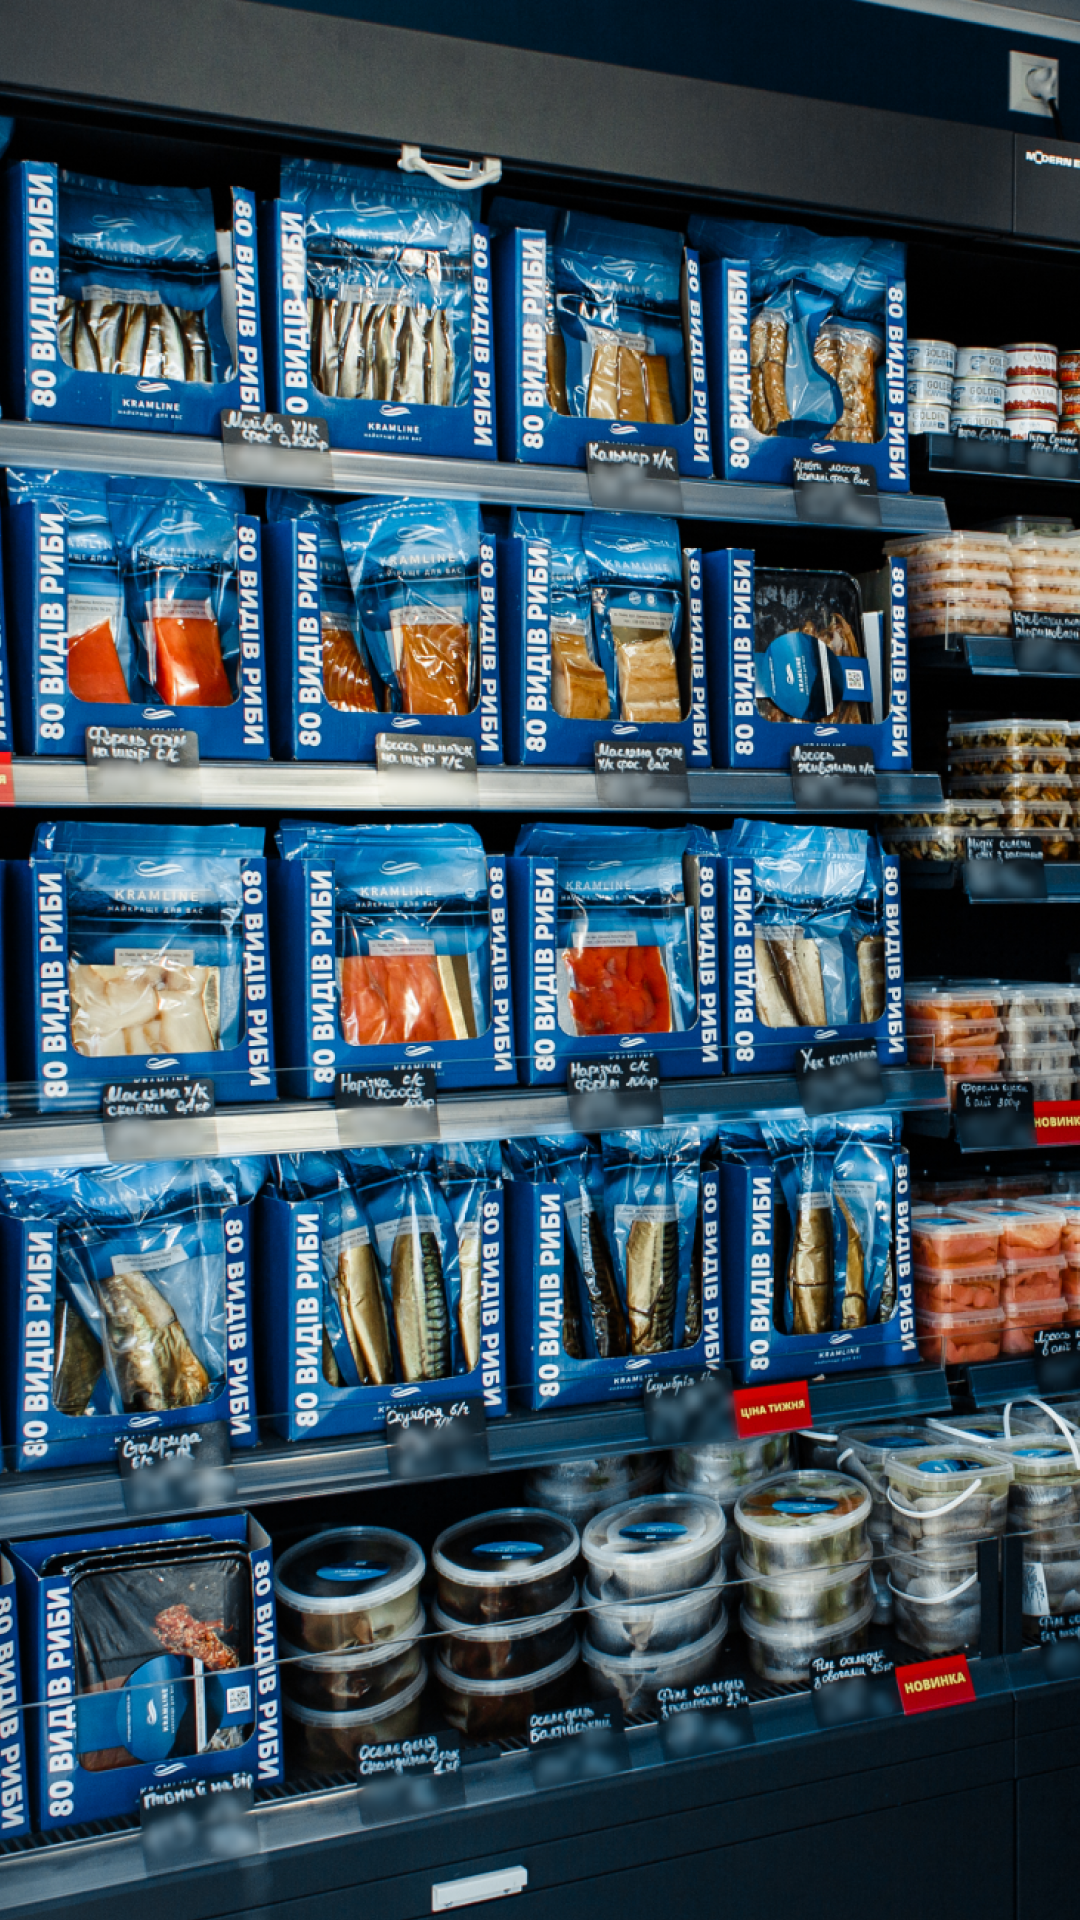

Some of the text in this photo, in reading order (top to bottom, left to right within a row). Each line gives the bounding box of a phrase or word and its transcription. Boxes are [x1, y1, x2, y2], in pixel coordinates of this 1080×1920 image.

[1025, 151, 1072, 167] MODERN
[28, 174, 59, 408] 80 ВИДІВ РИБИ
[472, 233, 494, 446] 80 ВИДІВ РИБИ
[522, 239, 547, 450] 80 ВИДІВ РИБИ
[727, 269, 751, 469] 80 ВИДІВ РИБИ
[886, 286, 907, 480] 80 ВИДІВ РИБИ
[122, 399, 180, 412] KRAMLINE
[223, 410, 286, 434] Мойва
[367, 422, 420, 434] KRAMLINE
[589, 443, 650, 468] Кальмар
[40, 513, 69, 740] 80 ВИДІВ РИБИ
[238, 526, 264, 744] 80 ВИДІВ РИБИ
[297, 532, 323, 746] 80 ВИДІВ РИБИ
[480, 544, 499, 751] 80 ВИДІВ РИБИ
[526, 548, 551, 752] 80 ВИДІВ РИБИ
[733, 560, 755, 755] 80 ВИДІВ РИБИ
[891, 566, 908, 757] 80 ВИДІВ РИБИ
[87, 726, 147, 749] Форель
[114, 889, 199, 902] KRAMLINE
[242, 870, 271, 1087] 80 ВИДІВ РИБИ
[310, 870, 336, 1084] 80 ВИДІВ РИБИ
[360, 886, 433, 897] KRAMLINE
[489, 866, 512, 1071] 80 ВИДІВ РИБИ
[534, 867, 557, 1071] 80 ВИДІВ РИБИ
[566, 880, 632, 891] KRAMLINE
[698, 866, 719, 1063] 80 ВИДІВ РИБИ
[733, 868, 756, 1062] 80 ВИДІВ РИБИ
[884, 866, 905, 1053] 80 ВИДІВ РИБИ
[38, 872, 70, 1098] 80 ВИДІВ РИБИ
[800, 1047, 825, 1073] Хек
[23, 1231, 55, 1457] 80 ВИДІВ РИБИ
[225, 1219, 251, 1436] 80 ВИДІВ РИБИ
[296, 1213, 323, 1427] 80 ВИДІВ РИБИ
[481, 1201, 502, 1406] 80 ВИДІВ РИБИ
[538, 1194, 563, 1397] 80 ВИДІВ РИБИ
[750, 1176, 774, 1370] 80 ВИДІВ РИБИ
[818, 1346, 861, 1359] KRAMLINE
[897, 1164, 916, 1351] 80 ВИДІВ РИБИ
[740, 1399, 805, 1419] ЦІНА ТИЖНЯ
[47, 1586, 76, 1816] 80 ВИДІВ РИБИ
[254, 1559, 279, 1780] 80 ВИДІВ РИБИ
[904, 1671, 966, 1694] НОВИНКА
